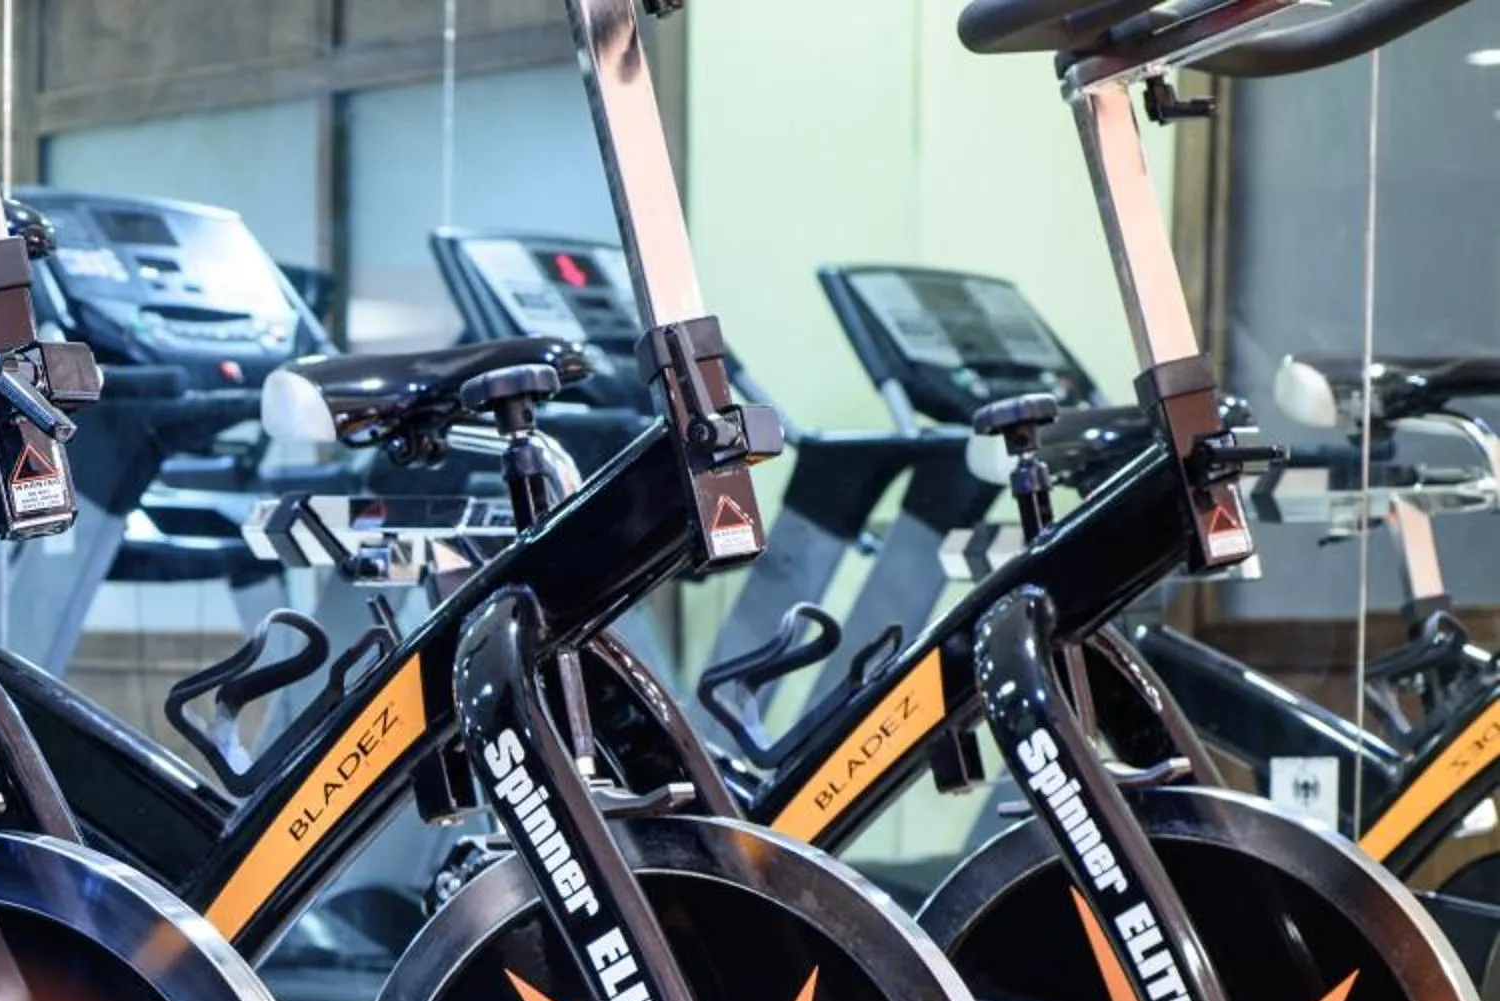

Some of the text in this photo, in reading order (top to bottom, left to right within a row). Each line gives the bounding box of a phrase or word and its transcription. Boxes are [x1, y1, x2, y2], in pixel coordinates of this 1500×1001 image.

[288, 706, 399, 842] BLADEZ
[483, 727, 600, 917] Spinner
[814, 696, 919, 811] BLADEZ
[1016, 727, 1129, 894] Spinner
